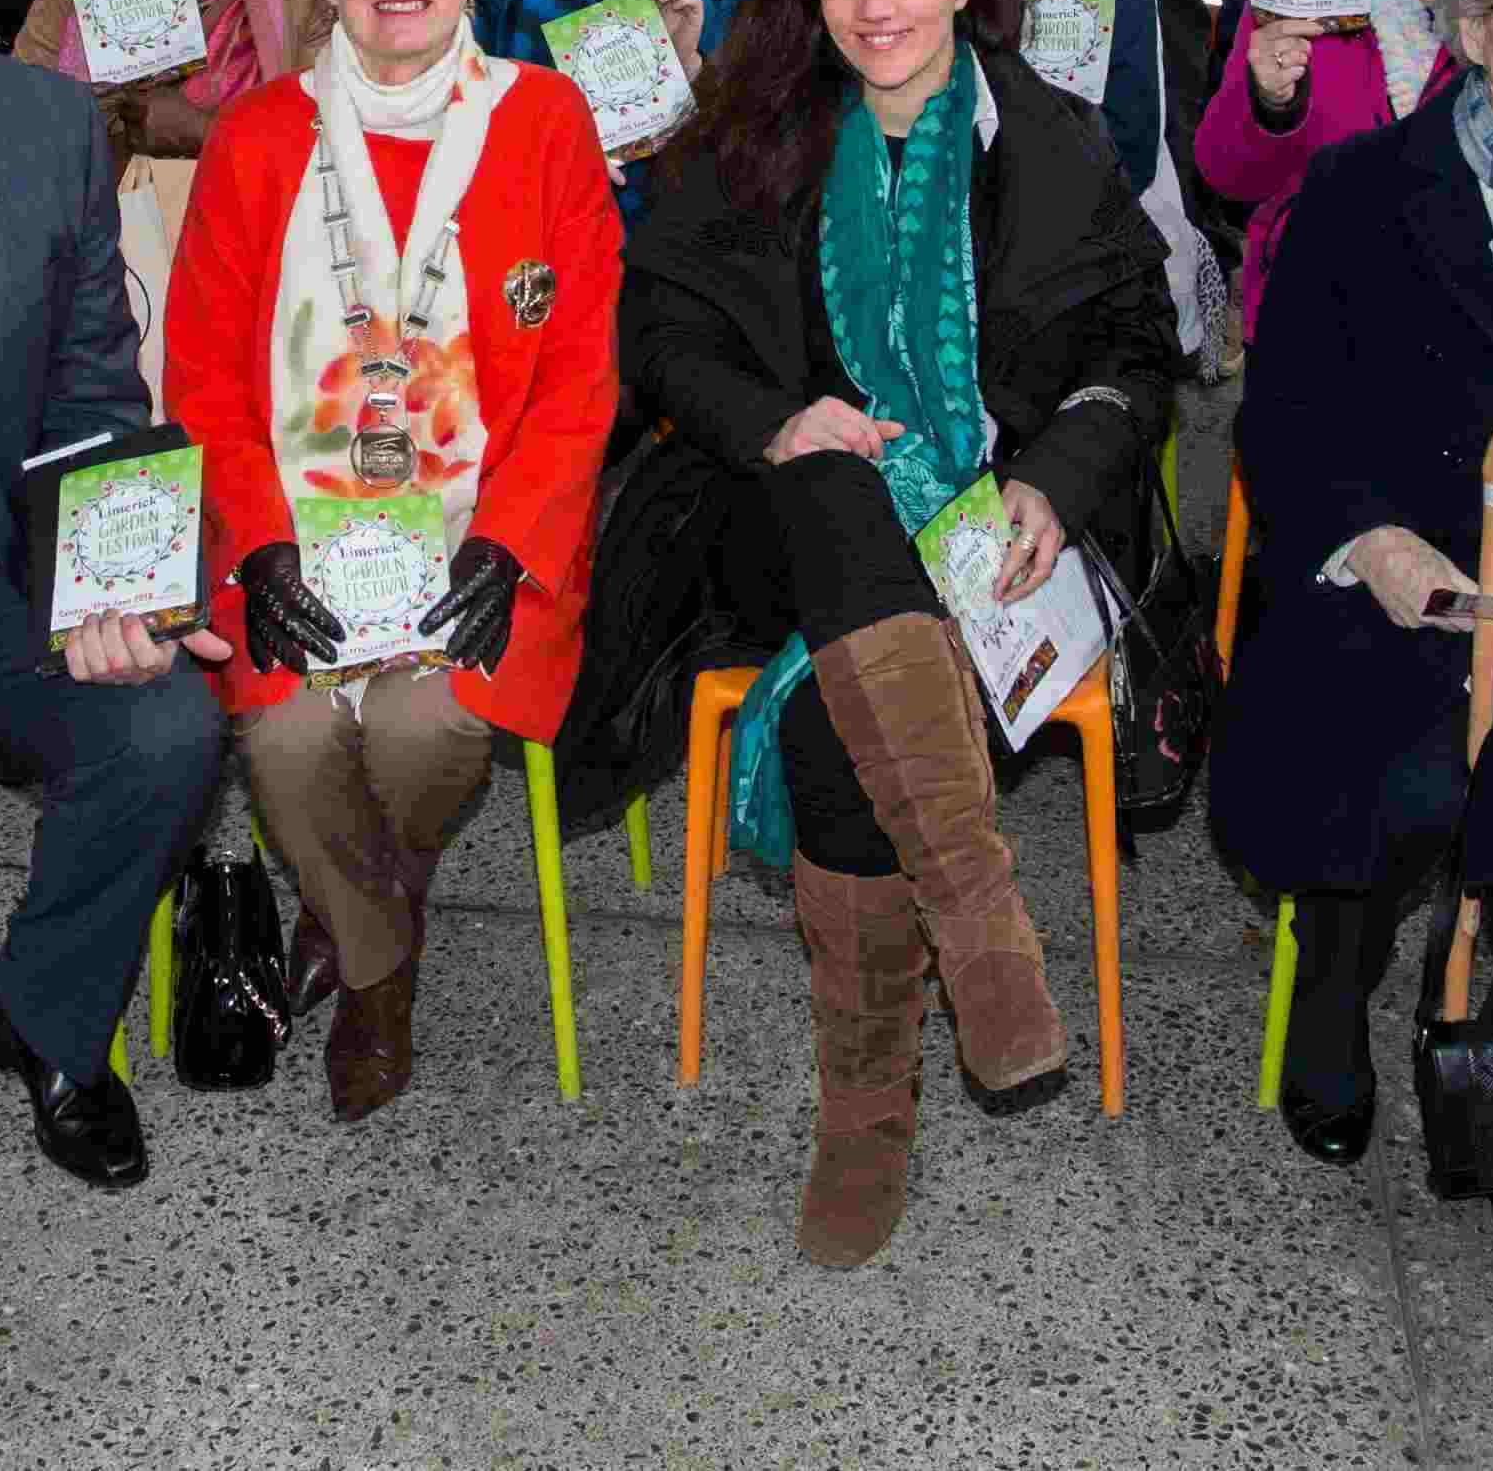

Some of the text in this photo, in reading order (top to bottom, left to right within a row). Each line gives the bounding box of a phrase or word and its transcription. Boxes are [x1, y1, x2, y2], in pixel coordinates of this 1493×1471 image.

[112, 2, 171, 27] FESTIVAL
[586, 32, 635, 58] Limerick
[593, 46, 644, 74] GARDEN
[597, 62, 650, 90] FESTIVAL
[99, 495, 157, 519] Limerick
[99, 508, 160, 539] GARDEN
[99, 528, 163, 558] FESTIVAL
[340, 543, 403, 559] Limerick
[344, 557, 406, 580] GARDEN
[346, 575, 413, 603] FESTIVAL
